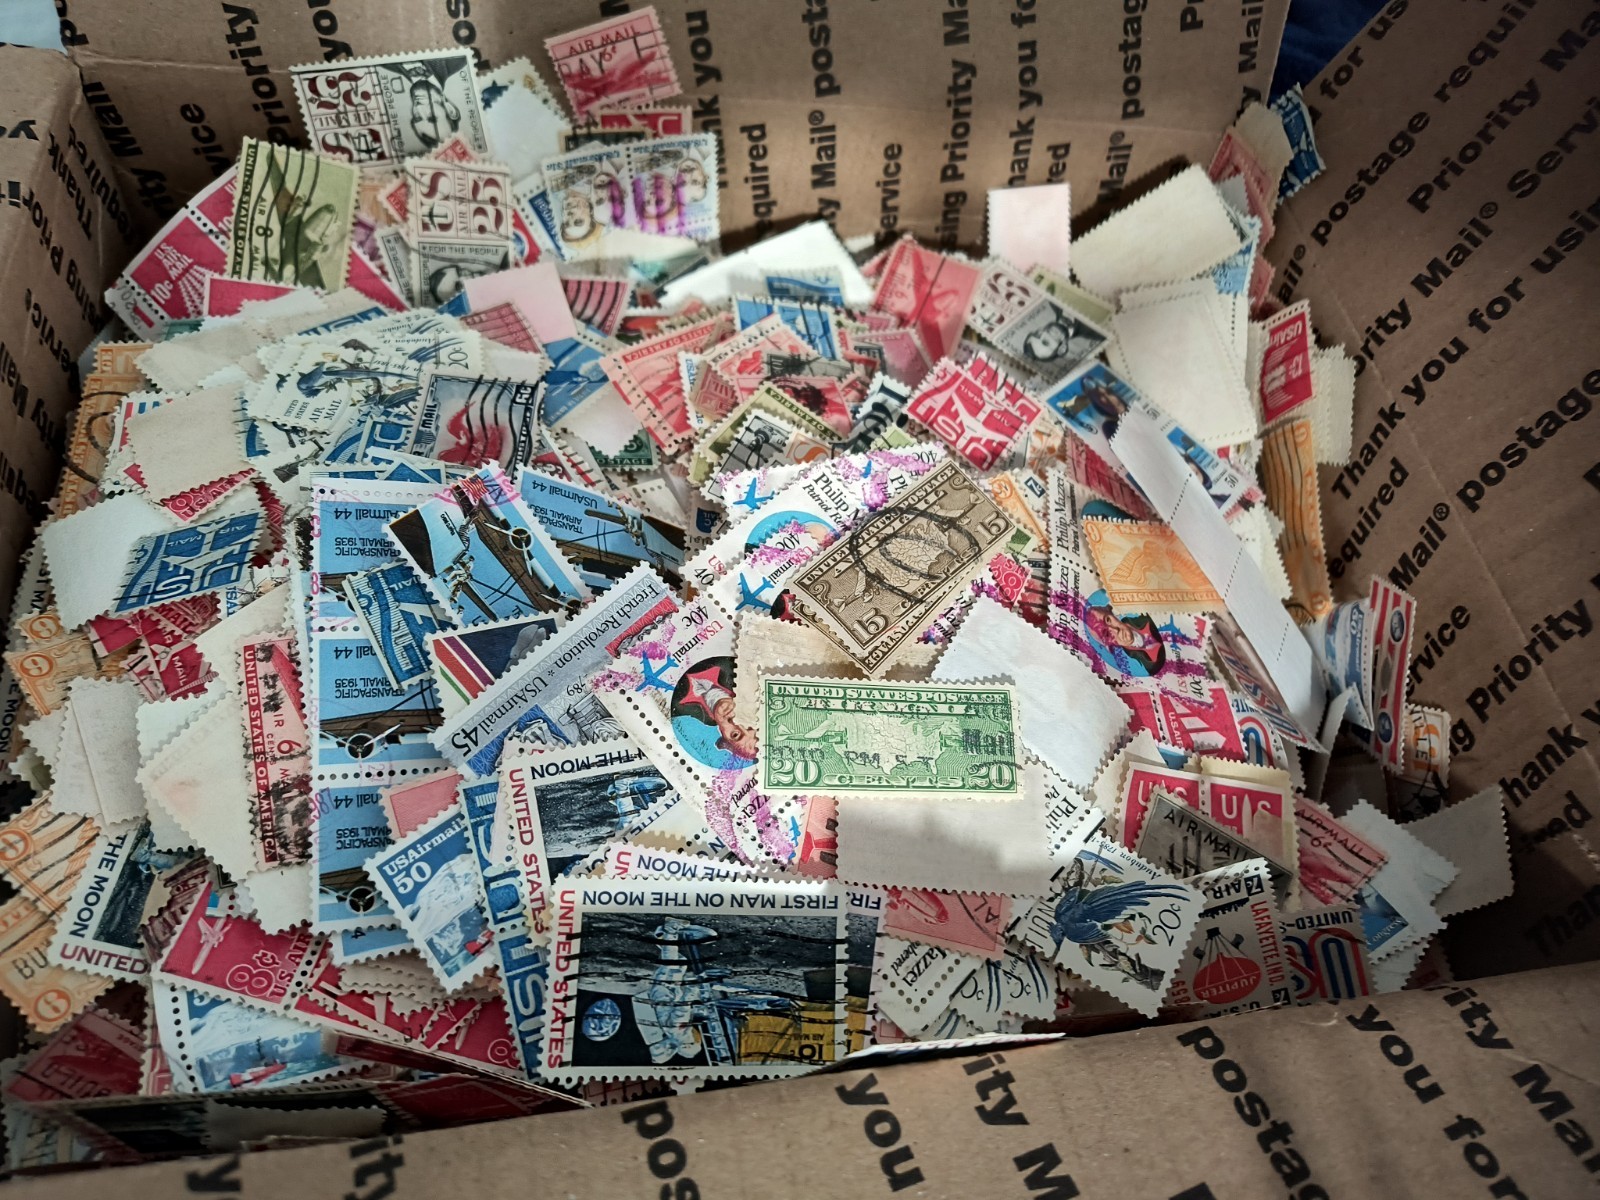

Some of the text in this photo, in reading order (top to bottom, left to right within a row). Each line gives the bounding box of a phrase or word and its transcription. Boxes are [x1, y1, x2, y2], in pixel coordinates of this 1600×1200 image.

[567, 25, 642, 57] AIR MAIL
[685, 10, 722, 87] you
[222, 2, 303, 150] Priority
[1017, 39, 1044, 111] you
[1320, 46, 1365, 99] for
[313, 114, 351, 129] MAIL
[939, 59, 977, 184] Priority
[1407, 78, 1541, 214] Priority
[48, 132, 92, 240] Thank
[1310, 111, 1431, 247] postage
[257, 196, 267, 216] AIR
[254, 225, 274, 239] 8
[162, 248, 182, 268] AIR
[170, 254, 195, 281] MAIL
[625, 342, 668, 363] AMERICA
[959, 384, 984, 406] MAIL
[1330, 276, 1524, 500] Thank you for
[308, 407, 326, 424] AIR
[324, 399, 343, 421] MAIL
[421, 403, 438, 430] MAIL
[768, 387, 810, 422] AMERICA
[532, 479, 548, 492] 44
[801, 483, 831, 514] Patriot
[812, 472, 851, 512] Philip
[334, 507, 353, 520] 44
[550, 509, 583, 525] AIRMAIL
[975, 510, 1010, 542] 15
[1055, 474, 1071, 553] Philip Mazzei
[334, 536, 358, 548] 1935
[681, 604, 711, 629] 40c
[851, 606, 889, 644] 15
[334, 646, 353, 660] 44
[672, 619, 726, 664] USAirmail
[171, 655, 187, 687] MAIL
[451, 583, 662, 758] French Revolution USAirmail 45
[1465, 600, 1594, 725] Priority
[334, 677, 358, 689] 1935
[770, 683, 1008, 705] UNITED STATES POSTAGE
[1190, 674, 1205, 699] 40c
[244, 650, 278, 859] UNITED STATES OF AMERICA
[277, 739, 302, 756] 6
[529, 749, 633, 780] MOON THE
[770, 758, 822, 787] 20
[968, 761, 1015, 791] 20
[835, 774, 965, 789] CENTS
[333, 795, 354, 809] 44
[335, 828, 360, 839] 1935
[1163, 808, 1199, 835] AIR
[1296, 807, 1365, 857] AIR MAIL
[380, 815, 466, 878] USAirmail
[508, 767, 552, 935] UNITED STATES
[392, 860, 432, 895] 50
[636, 854, 697, 879] MOON
[1118, 850, 1163, 880] Audubon
[582, 890, 840, 910] FIRST MAN ON THE MOON
[1213, 882, 1242, 900] AIR
[68, 874, 110, 940] MOON
[59, 942, 150, 977] UNITED
[547, 888, 577, 1070] UNITED STATES
[1200, 975, 1258, 1000] JUPITER
[1346, 1004, 1446, 1105] you
[834, 1072, 926, 1193] you
